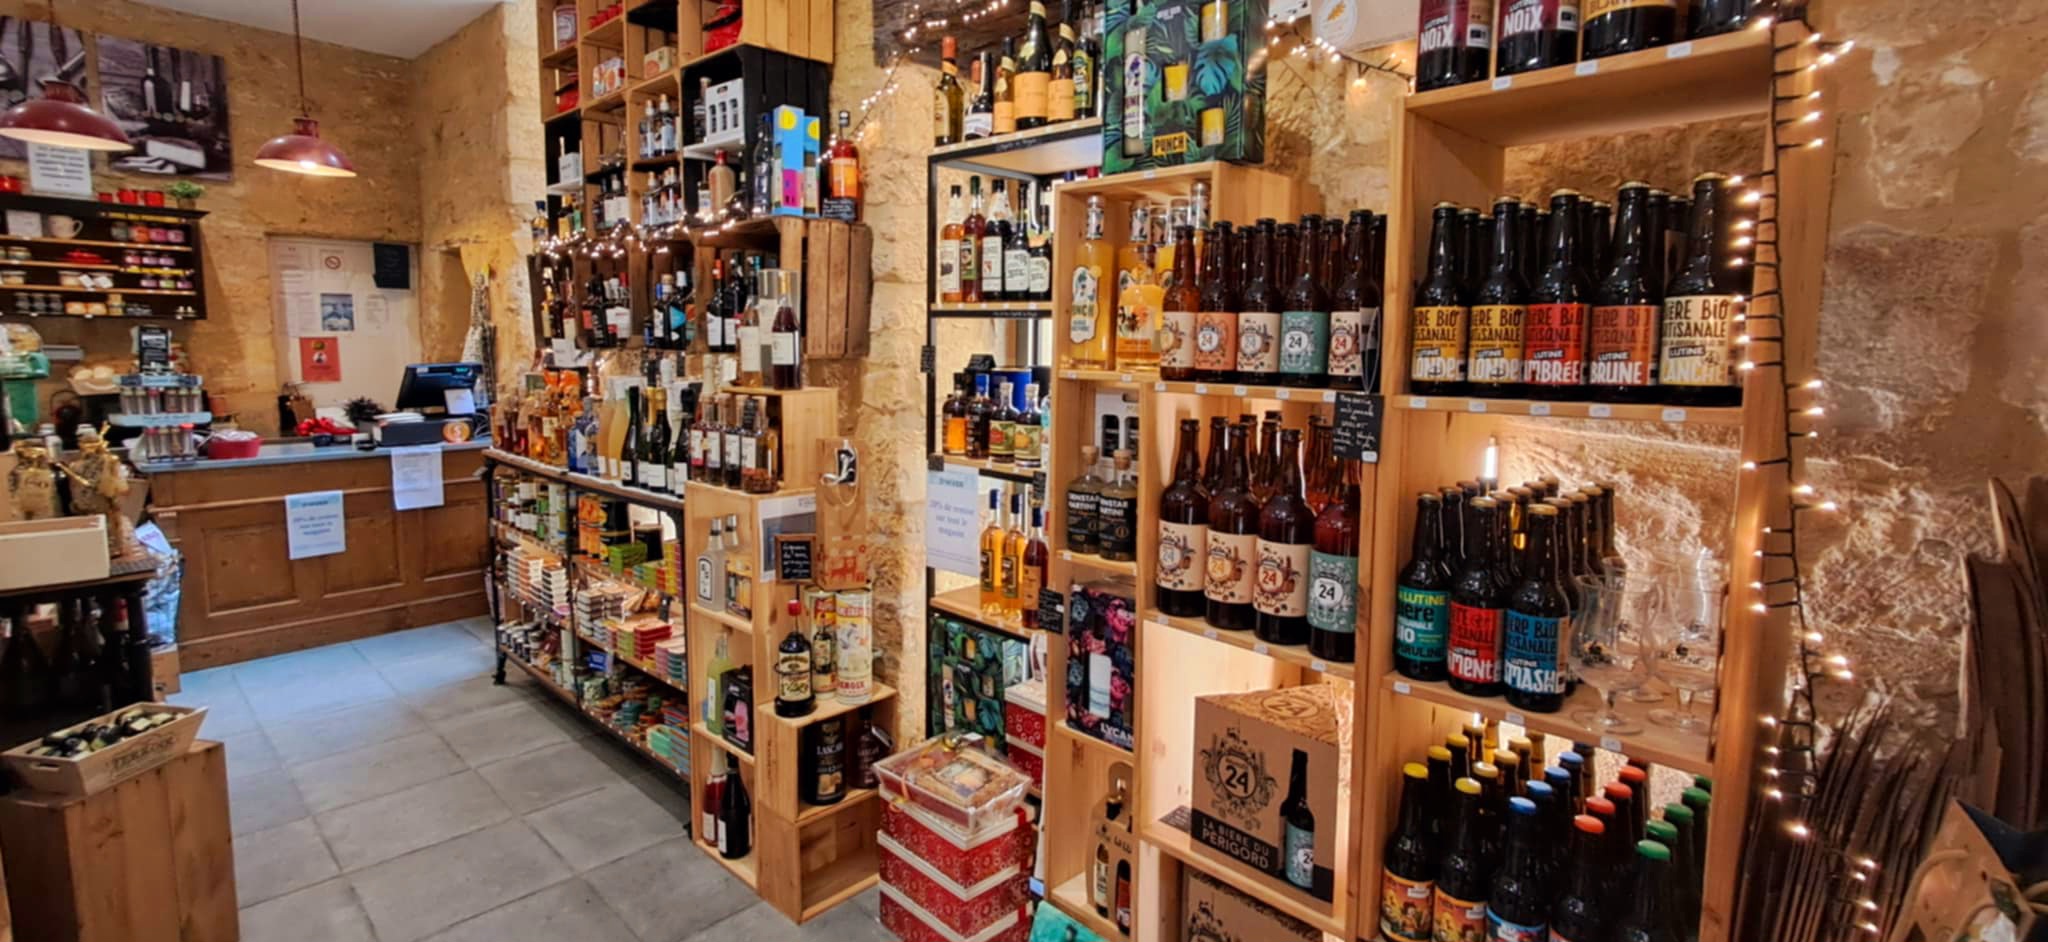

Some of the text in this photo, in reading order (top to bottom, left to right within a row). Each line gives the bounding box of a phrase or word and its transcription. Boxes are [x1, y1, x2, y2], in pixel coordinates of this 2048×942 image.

[1288, 336, 1303, 348] 24
[1263, 570, 1276, 585] 24
[1319, 586, 1335, 599] 24
[1224, 765, 1249, 794] 24
[1202, 818, 1216, 830] LA
[1254, 845, 1269, 857] DU
